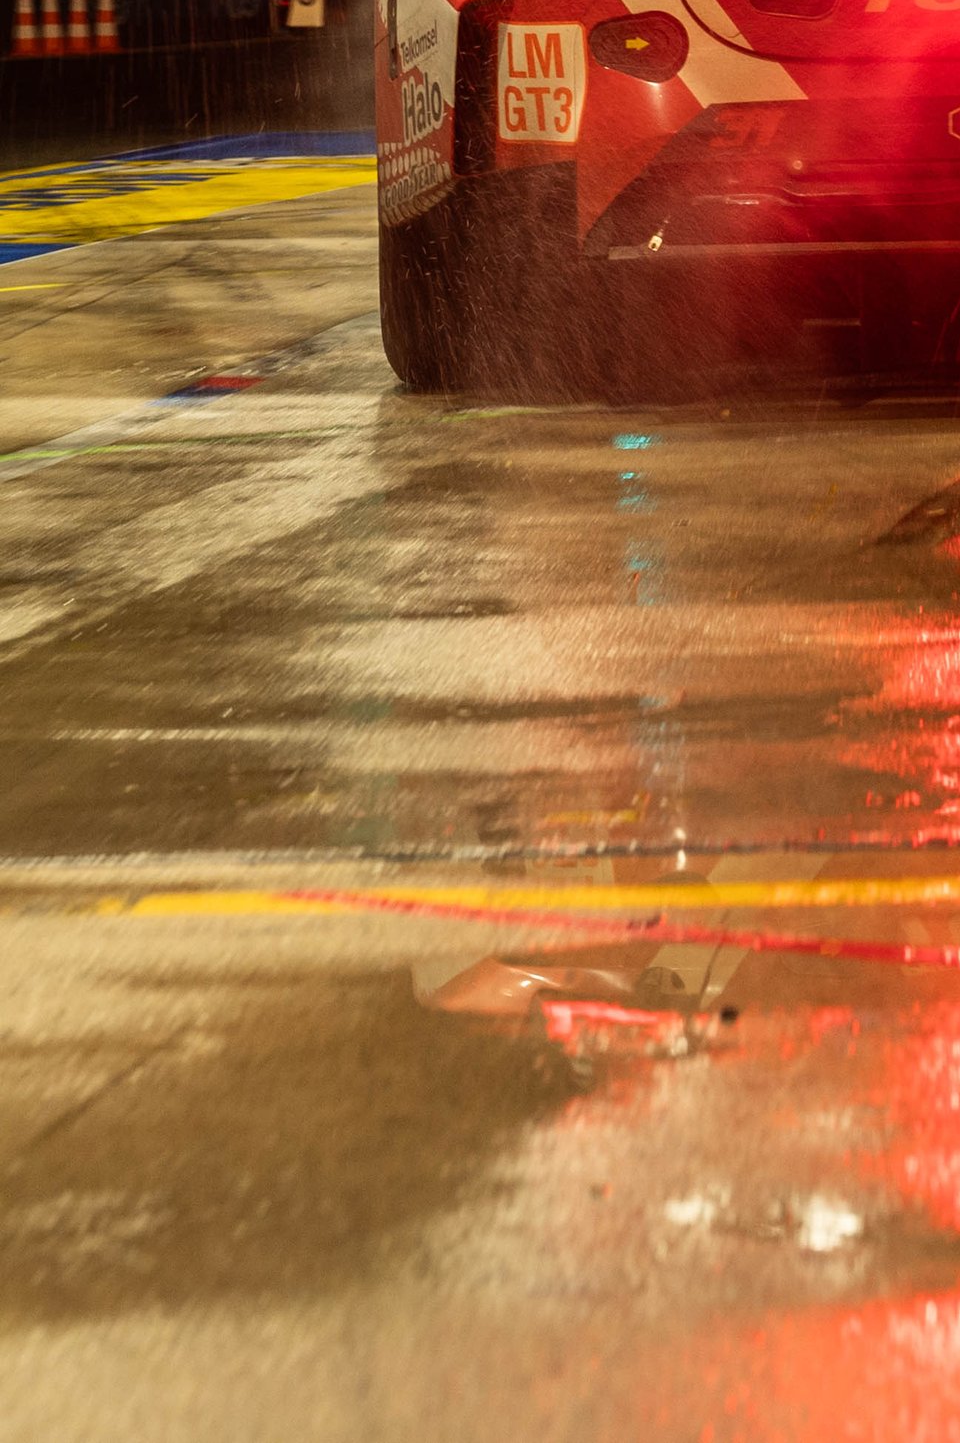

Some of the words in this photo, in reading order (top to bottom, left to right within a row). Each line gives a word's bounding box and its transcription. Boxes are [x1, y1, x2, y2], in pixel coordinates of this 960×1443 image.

[400, 20, 437, 65] Telkomsel
[507, 32, 564, 79] LM
[402, 71, 443, 142] Halo
[504, 85, 573, 133] GT3
[384, 161, 438, 208] GOODYEAR
